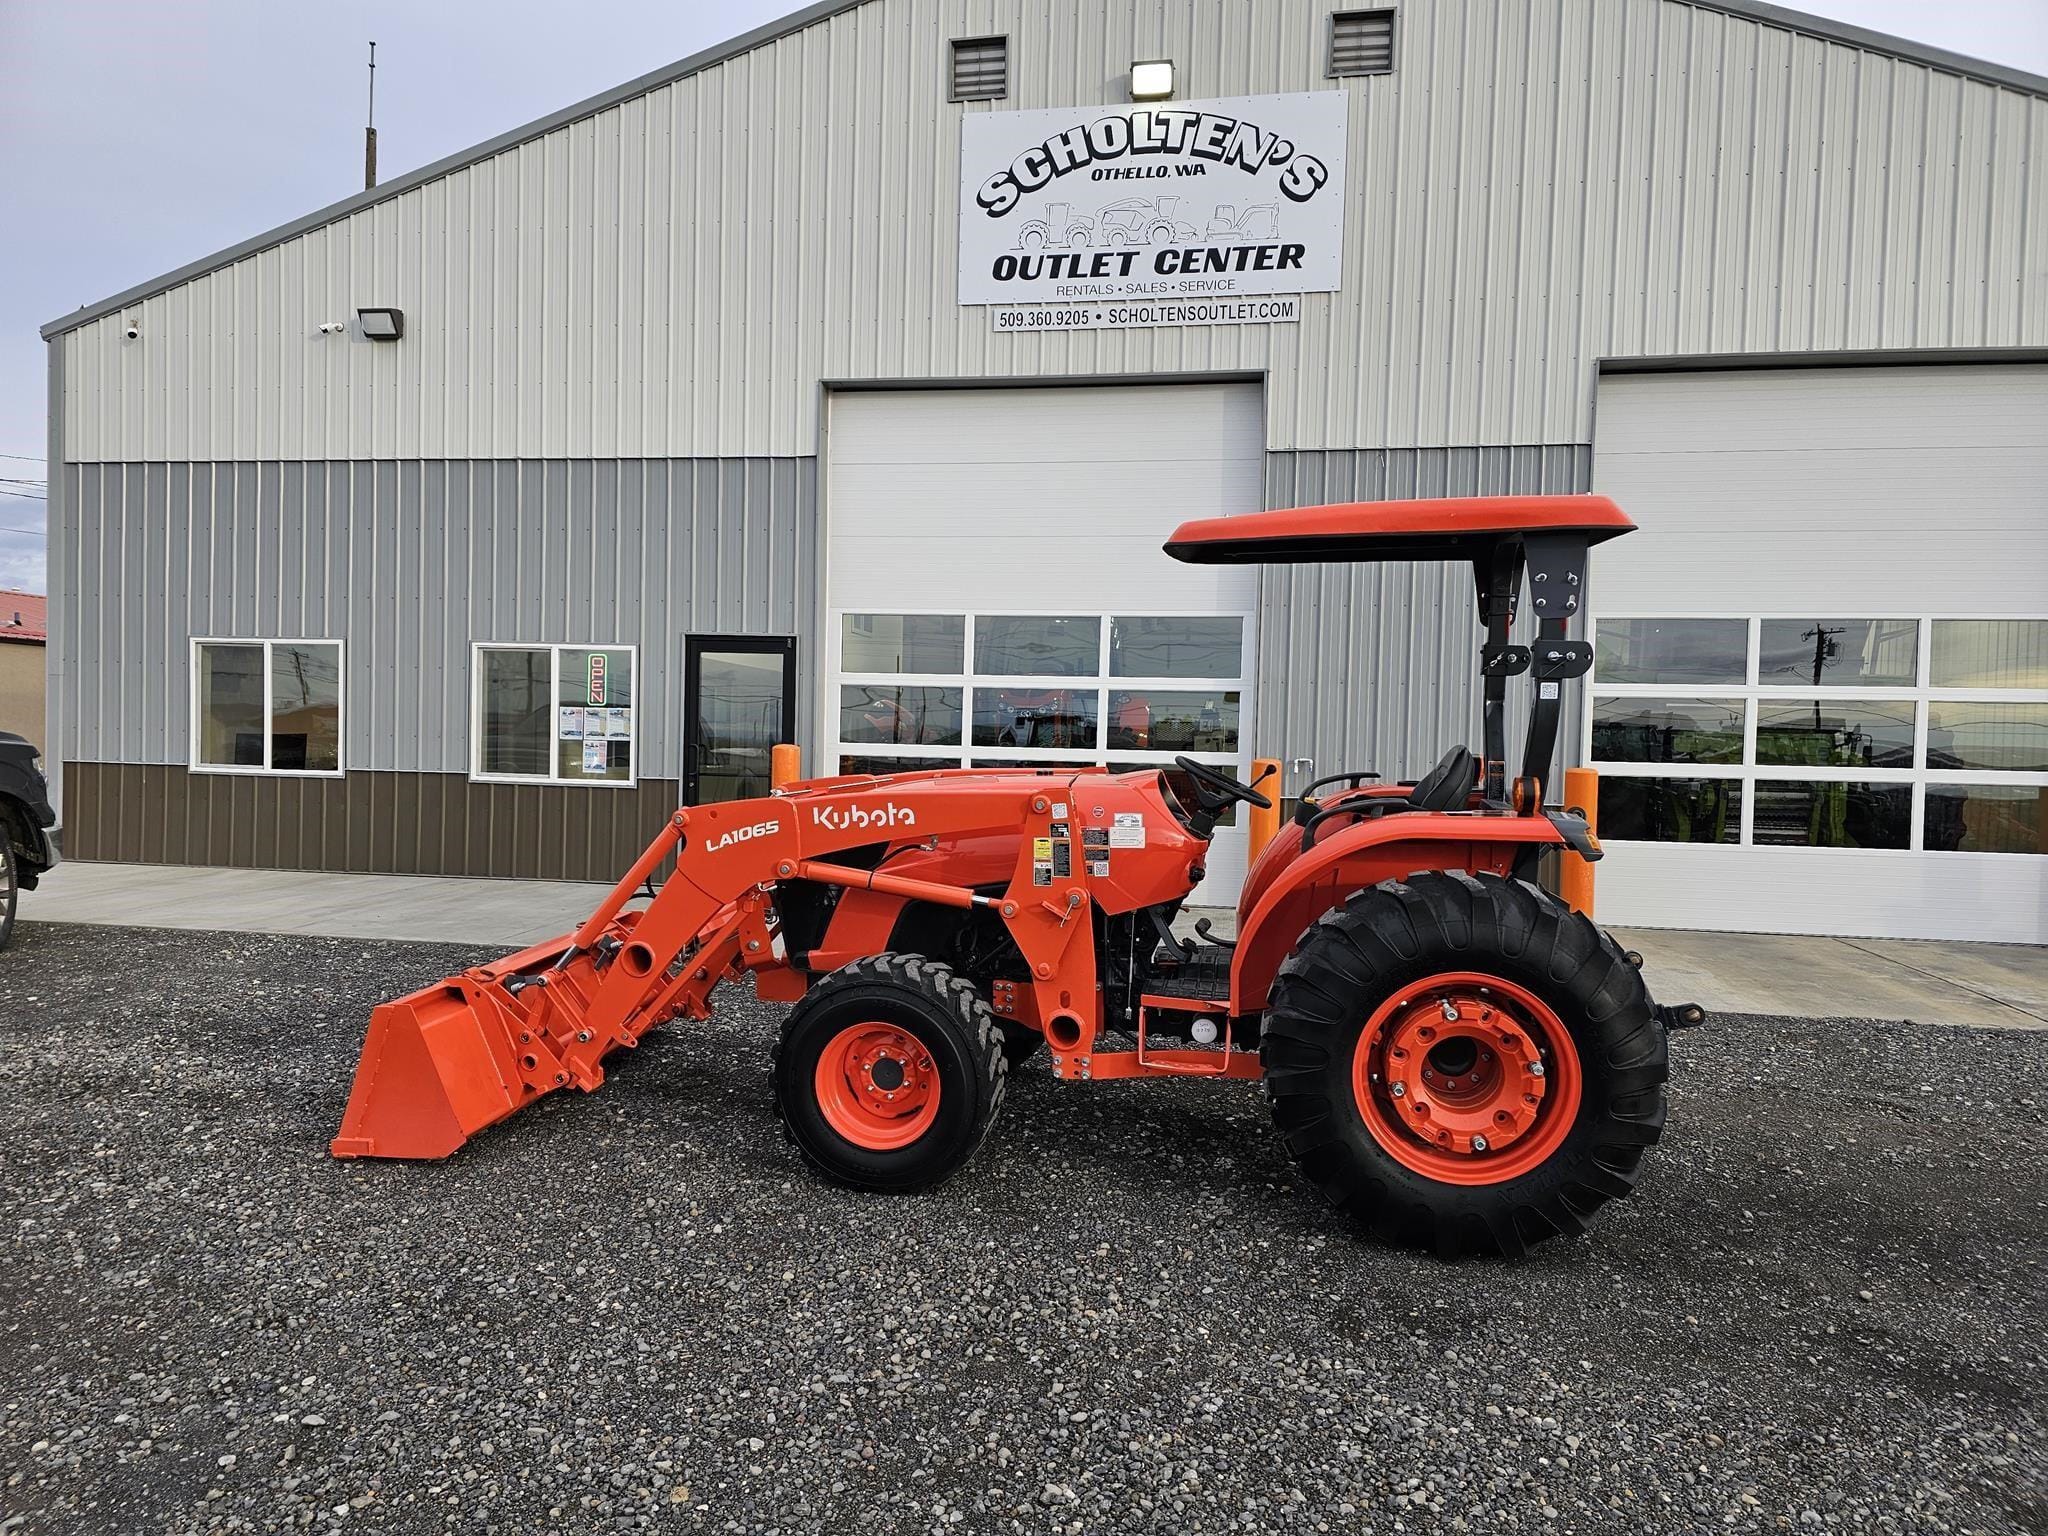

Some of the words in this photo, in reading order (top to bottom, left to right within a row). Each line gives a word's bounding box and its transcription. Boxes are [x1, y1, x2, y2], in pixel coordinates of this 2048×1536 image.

[976, 111, 1328, 218] SCHOLTEN'S
[1175, 163, 1206, 177] WA
[992, 251, 1139, 281] OUTLET
[1153, 244, 1305, 274] CENTER
[1056, 285, 1114, 296] RENTALS
[1126, 281, 1168, 293] SALES
[1179, 279, 1236, 291] SERVICE
[999, 310, 1089, 327] 509.360.9205
[1108, 302, 1294, 324] SCHOLTENSOUTLET.COM
[591, 657, 604, 702] OPEN
[813, 802, 915, 830] Kubota
[706, 820, 779, 852] LA1065
